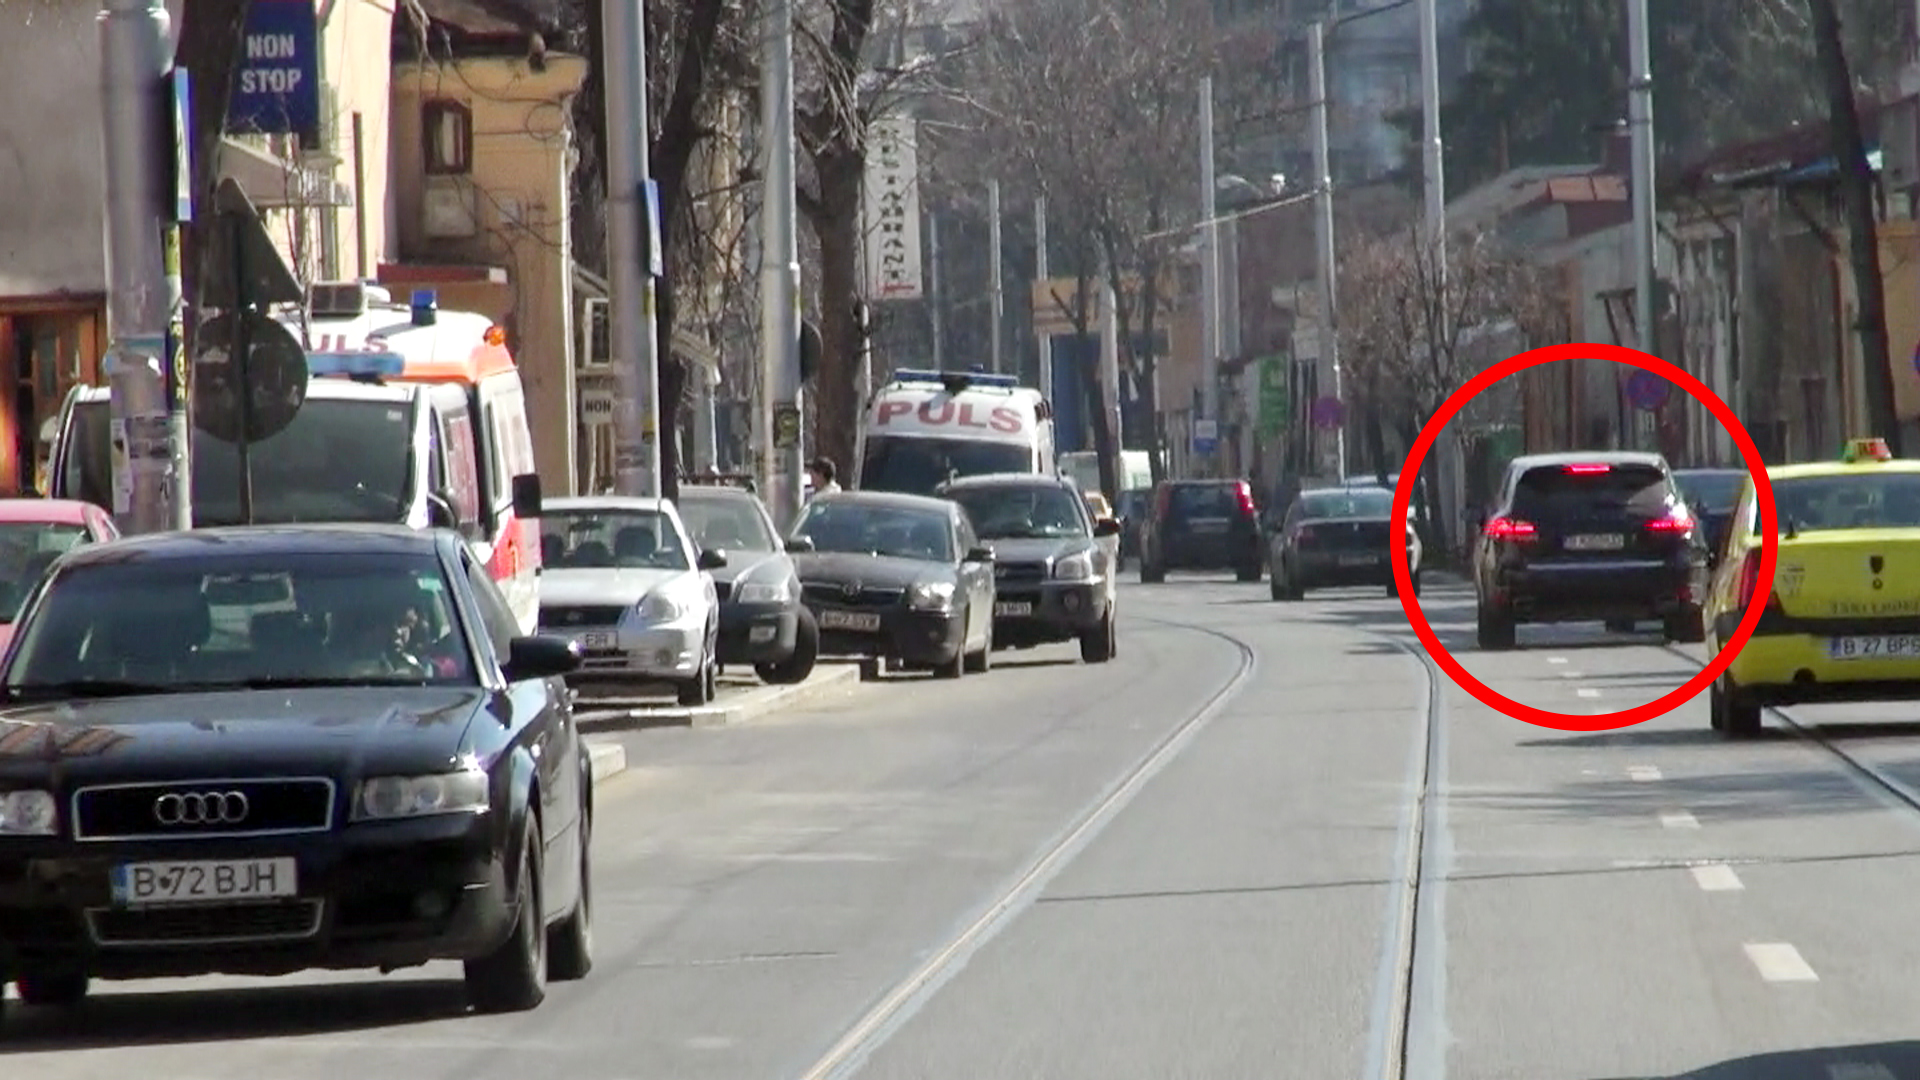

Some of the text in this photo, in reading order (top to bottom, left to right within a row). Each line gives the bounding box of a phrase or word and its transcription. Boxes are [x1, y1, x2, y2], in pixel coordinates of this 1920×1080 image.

[247, 33, 295, 58] NON
[241, 68, 302, 93] STOP
[877, 400, 1022, 434] PULS
[214, 862, 277, 894] BJH
